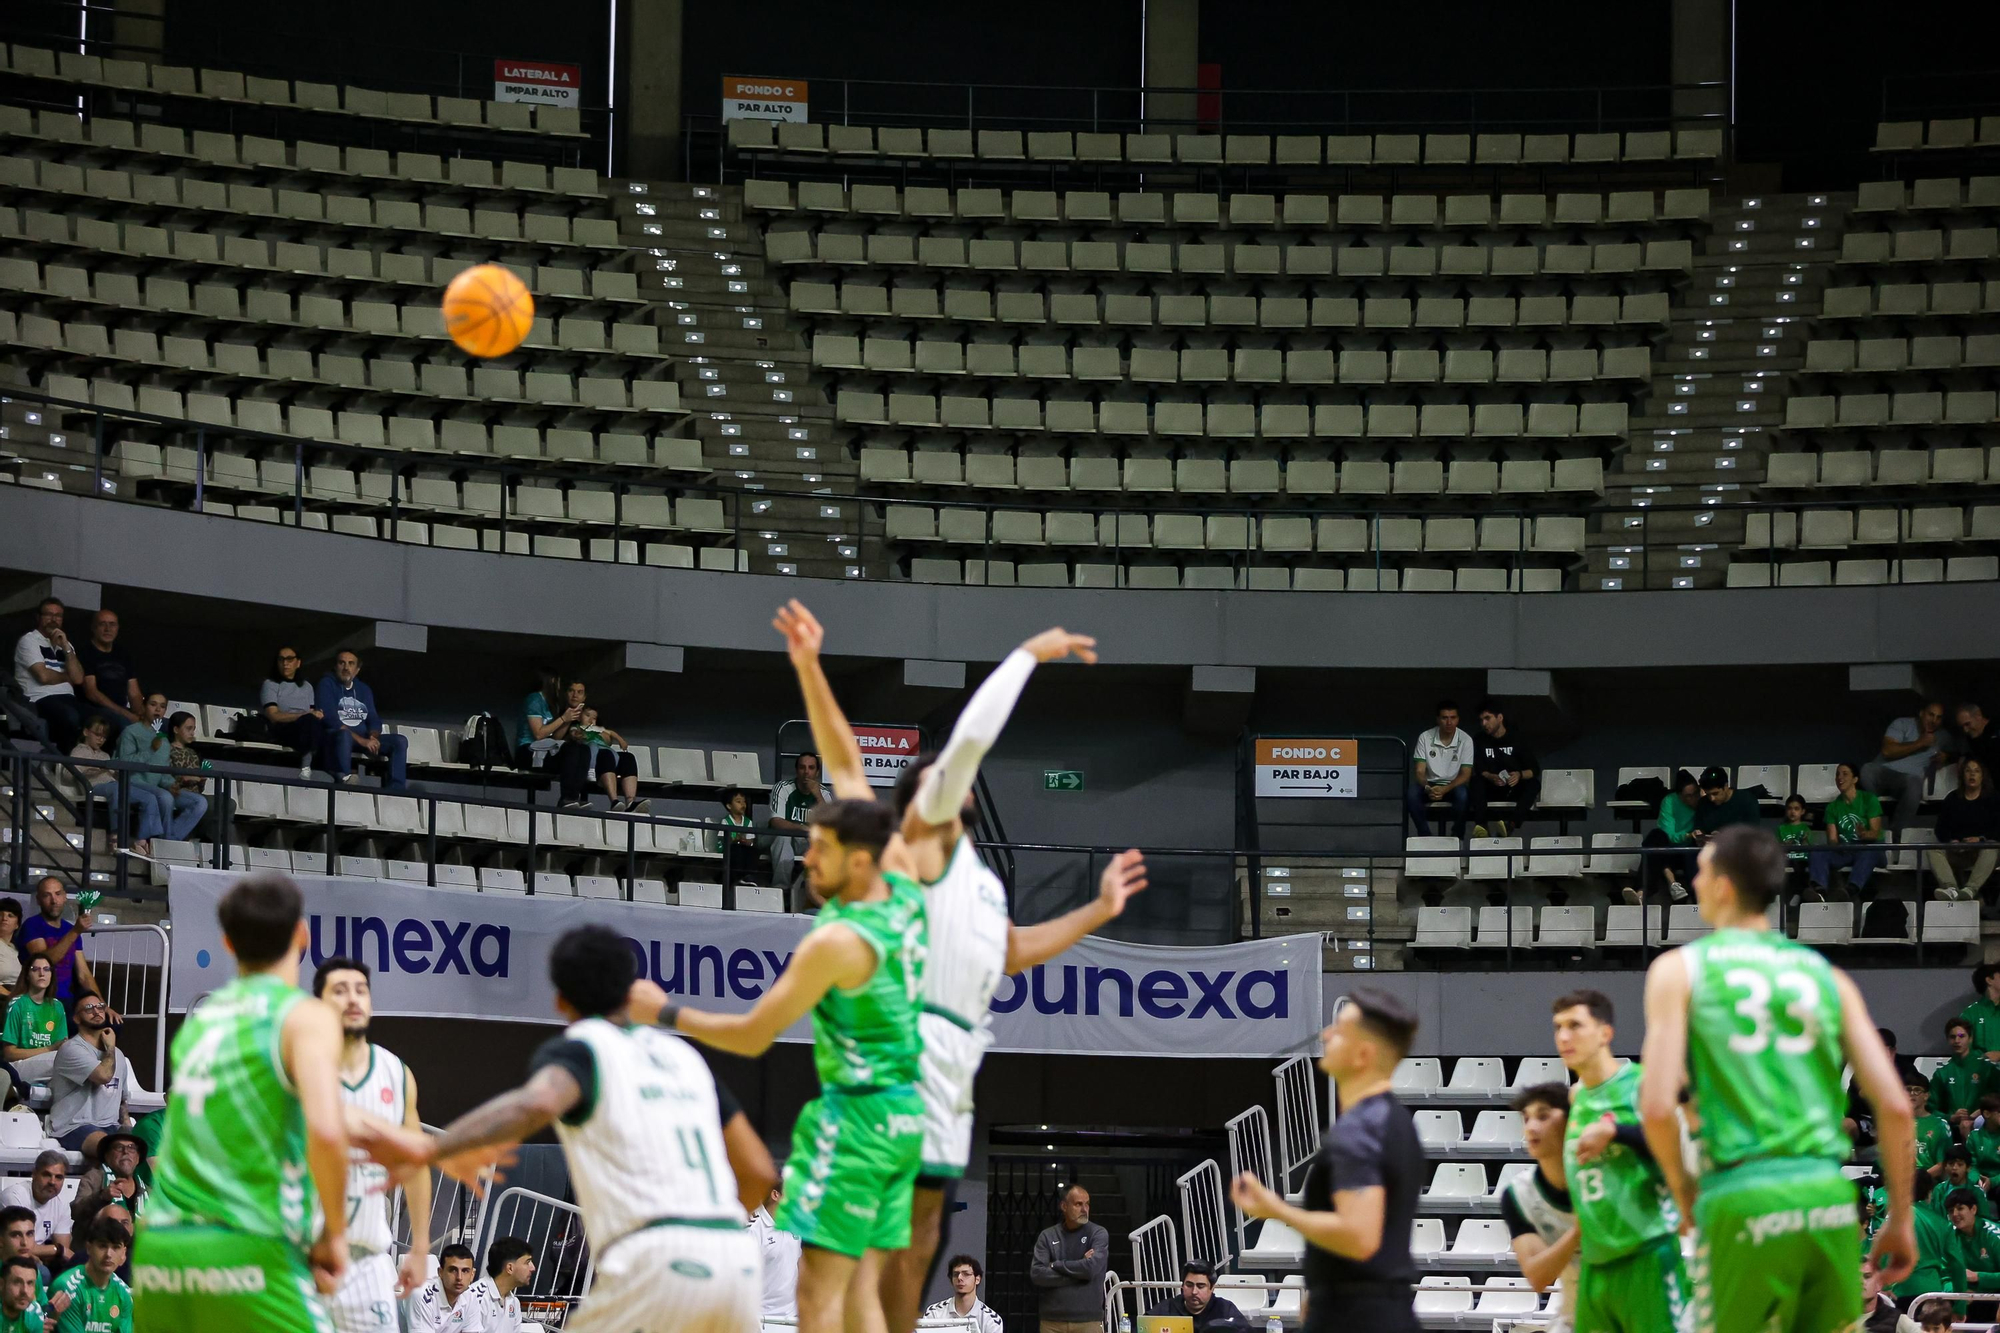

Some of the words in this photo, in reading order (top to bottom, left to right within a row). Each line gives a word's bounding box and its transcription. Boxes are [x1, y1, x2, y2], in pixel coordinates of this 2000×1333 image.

[504, 67, 558, 82] LATERAL
[560, 72, 570, 82] A
[505, 85, 539, 98] IMPAR
[541, 88, 569, 99] ALTO
[737, 84, 782, 97] FONDO
[785, 86, 794, 97] C
[738, 103, 761, 113] PAR
[763, 103, 793, 114] ALTO
[853, 735, 896, 748] TERAL
[898, 737, 909, 749] A
[1272, 747, 1327, 759] FONDO
[1330, 747, 1341, 759] C
[876, 758, 908, 769] BAJO
[1272, 769, 1300, 780] PAR
[1303, 769, 1340, 780] BAJO
[300, 914, 511, 978] unexa
[622, 936, 795, 1001] ounex
[988, 963, 1289, 1020] ounexa
[1724, 968, 1820, 1055] 33
[172, 1024, 226, 1116] 4
[676, 1126, 719, 1205] 4
[1575, 1167, 1605, 1203] 13
